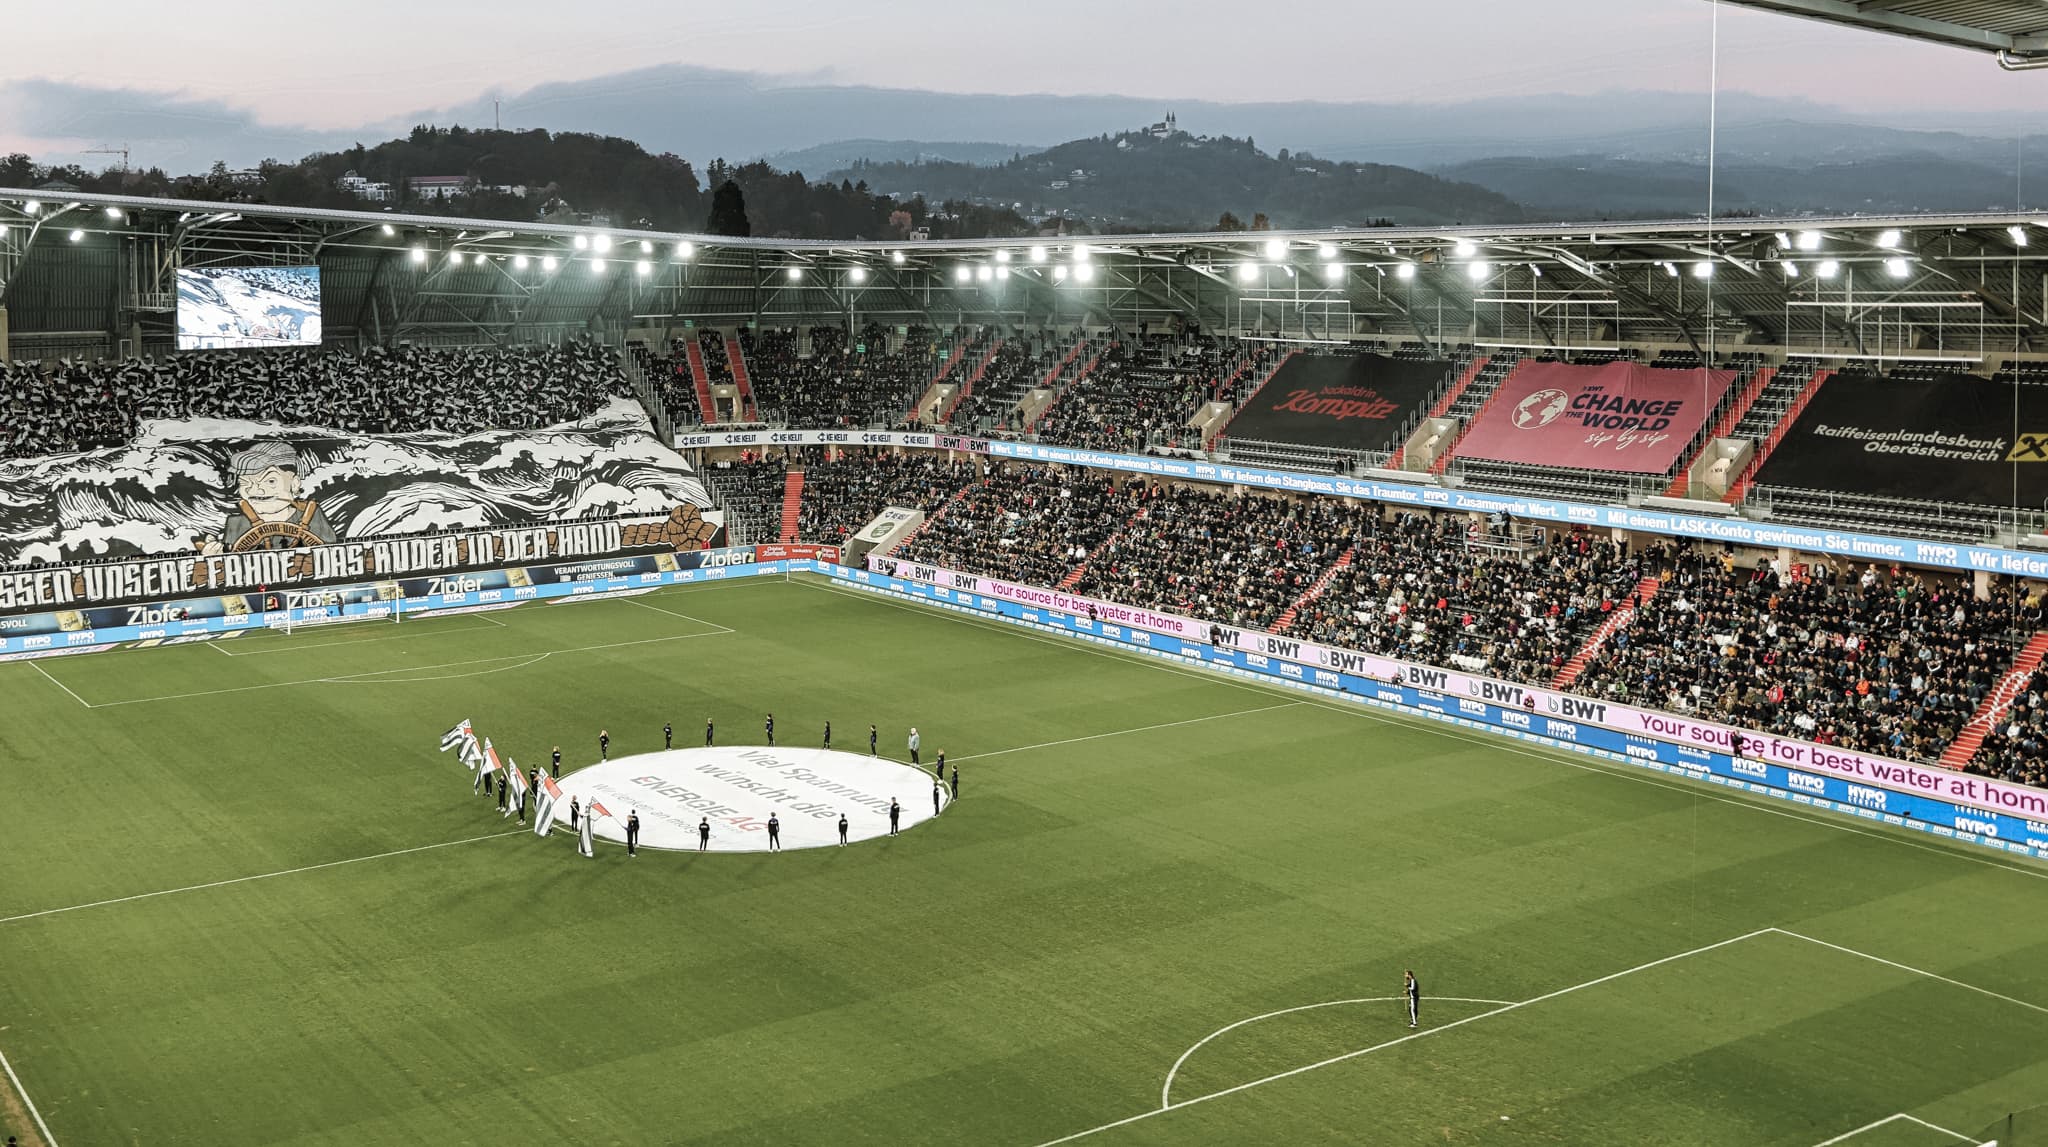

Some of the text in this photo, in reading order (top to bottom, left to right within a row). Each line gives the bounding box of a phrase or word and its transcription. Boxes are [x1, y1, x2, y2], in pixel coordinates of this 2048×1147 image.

[1571, 393, 1684, 417] CHANGE
[1582, 412, 1671, 431] WORLD
[943, 437, 961, 449] BWT
[970, 440, 989, 451] BWT
[1584, 424, 1670, 450] sip by sip
[1813, 424, 2007, 451] Raiffeisenlandesbank
[1864, 440, 2000, 463] Oberösterreich
[1195, 465, 1216, 475] HYPO
[1221, 469, 1234, 480] Wir
[1265, 475, 1281, 485] den
[1336, 482, 1351, 493] Sie
[1353, 484, 1369, 496] das
[1372, 486, 1419, 501] Traumtor.
[1423, 490, 1449, 501] HYPO
[1528, 502, 1559, 517] Wert.
[1568, 505, 1597, 518] HYPO
[1607, 510, 1905, 557] Mit einem LASK-Konto gewinnen Sie immer.
[700, 549, 750, 568] Zipfer
[1917, 544, 1958, 559] HYPO
[1968, 551, 1999, 568] Wir
[83, 558, 197, 602] UNSERE
[312, 544, 364, 580] DAS
[374, 535, 459, 575] RUDER
[467, 533, 494, 565] IN
[502, 527, 550, 562] DER
[557, 521, 621, 557] HAND
[554, 560, 636, 575] VERANTWORTUNGSVOLL
[915, 566, 937, 582] BWT
[955, 574, 978, 590] BWT
[427, 575, 485, 596] Zipfer
[991, 582, 1013, 596] Your
[1016, 588, 1051, 604] source
[1053, 593, 1069, 608] for
[1098, 605, 1132, 620] water
[1134, 611, 1146, 625] at
[1148, 614, 1183, 632] home
[1212, 627, 1240, 646] WT
[1267, 637, 1300, 659] BWT
[1280, 662, 1303, 675] HYPO
[1330, 651, 1366, 672] BWT
[1315, 670, 1339, 683] HYPO
[1409, 666, 1448, 690] BWT
[1378, 690, 1403, 703] HYPO
[1482, 680, 1523, 706] BWT
[1460, 698, 1486, 712] HYPO
[1561, 697, 1606, 723] BWT
[1501, 710, 1530, 724] HYPO
[1547, 719, 1576, 735] HYPO
[738, 750, 795, 769] Viel
[1626, 744, 1658, 760] HYPO
[1640, 714, 1686, 737] Your
[1771, 739, 1804, 761] for
[1811, 747, 1864, 775] best
[1870, 763, 1943, 790] water
[1950, 780, 1976, 799] at
[1984, 782, 2048, 813] hom
[1731, 756, 1767, 773] HYPO
[1788, 771, 1825, 789] HYPO
[630, 775, 739, 818] ENERGIE
[696, 764, 837, 819] wünscht die
[1847, 784, 1887, 803] HYPO
[1954, 816, 1998, 837] HYPO
